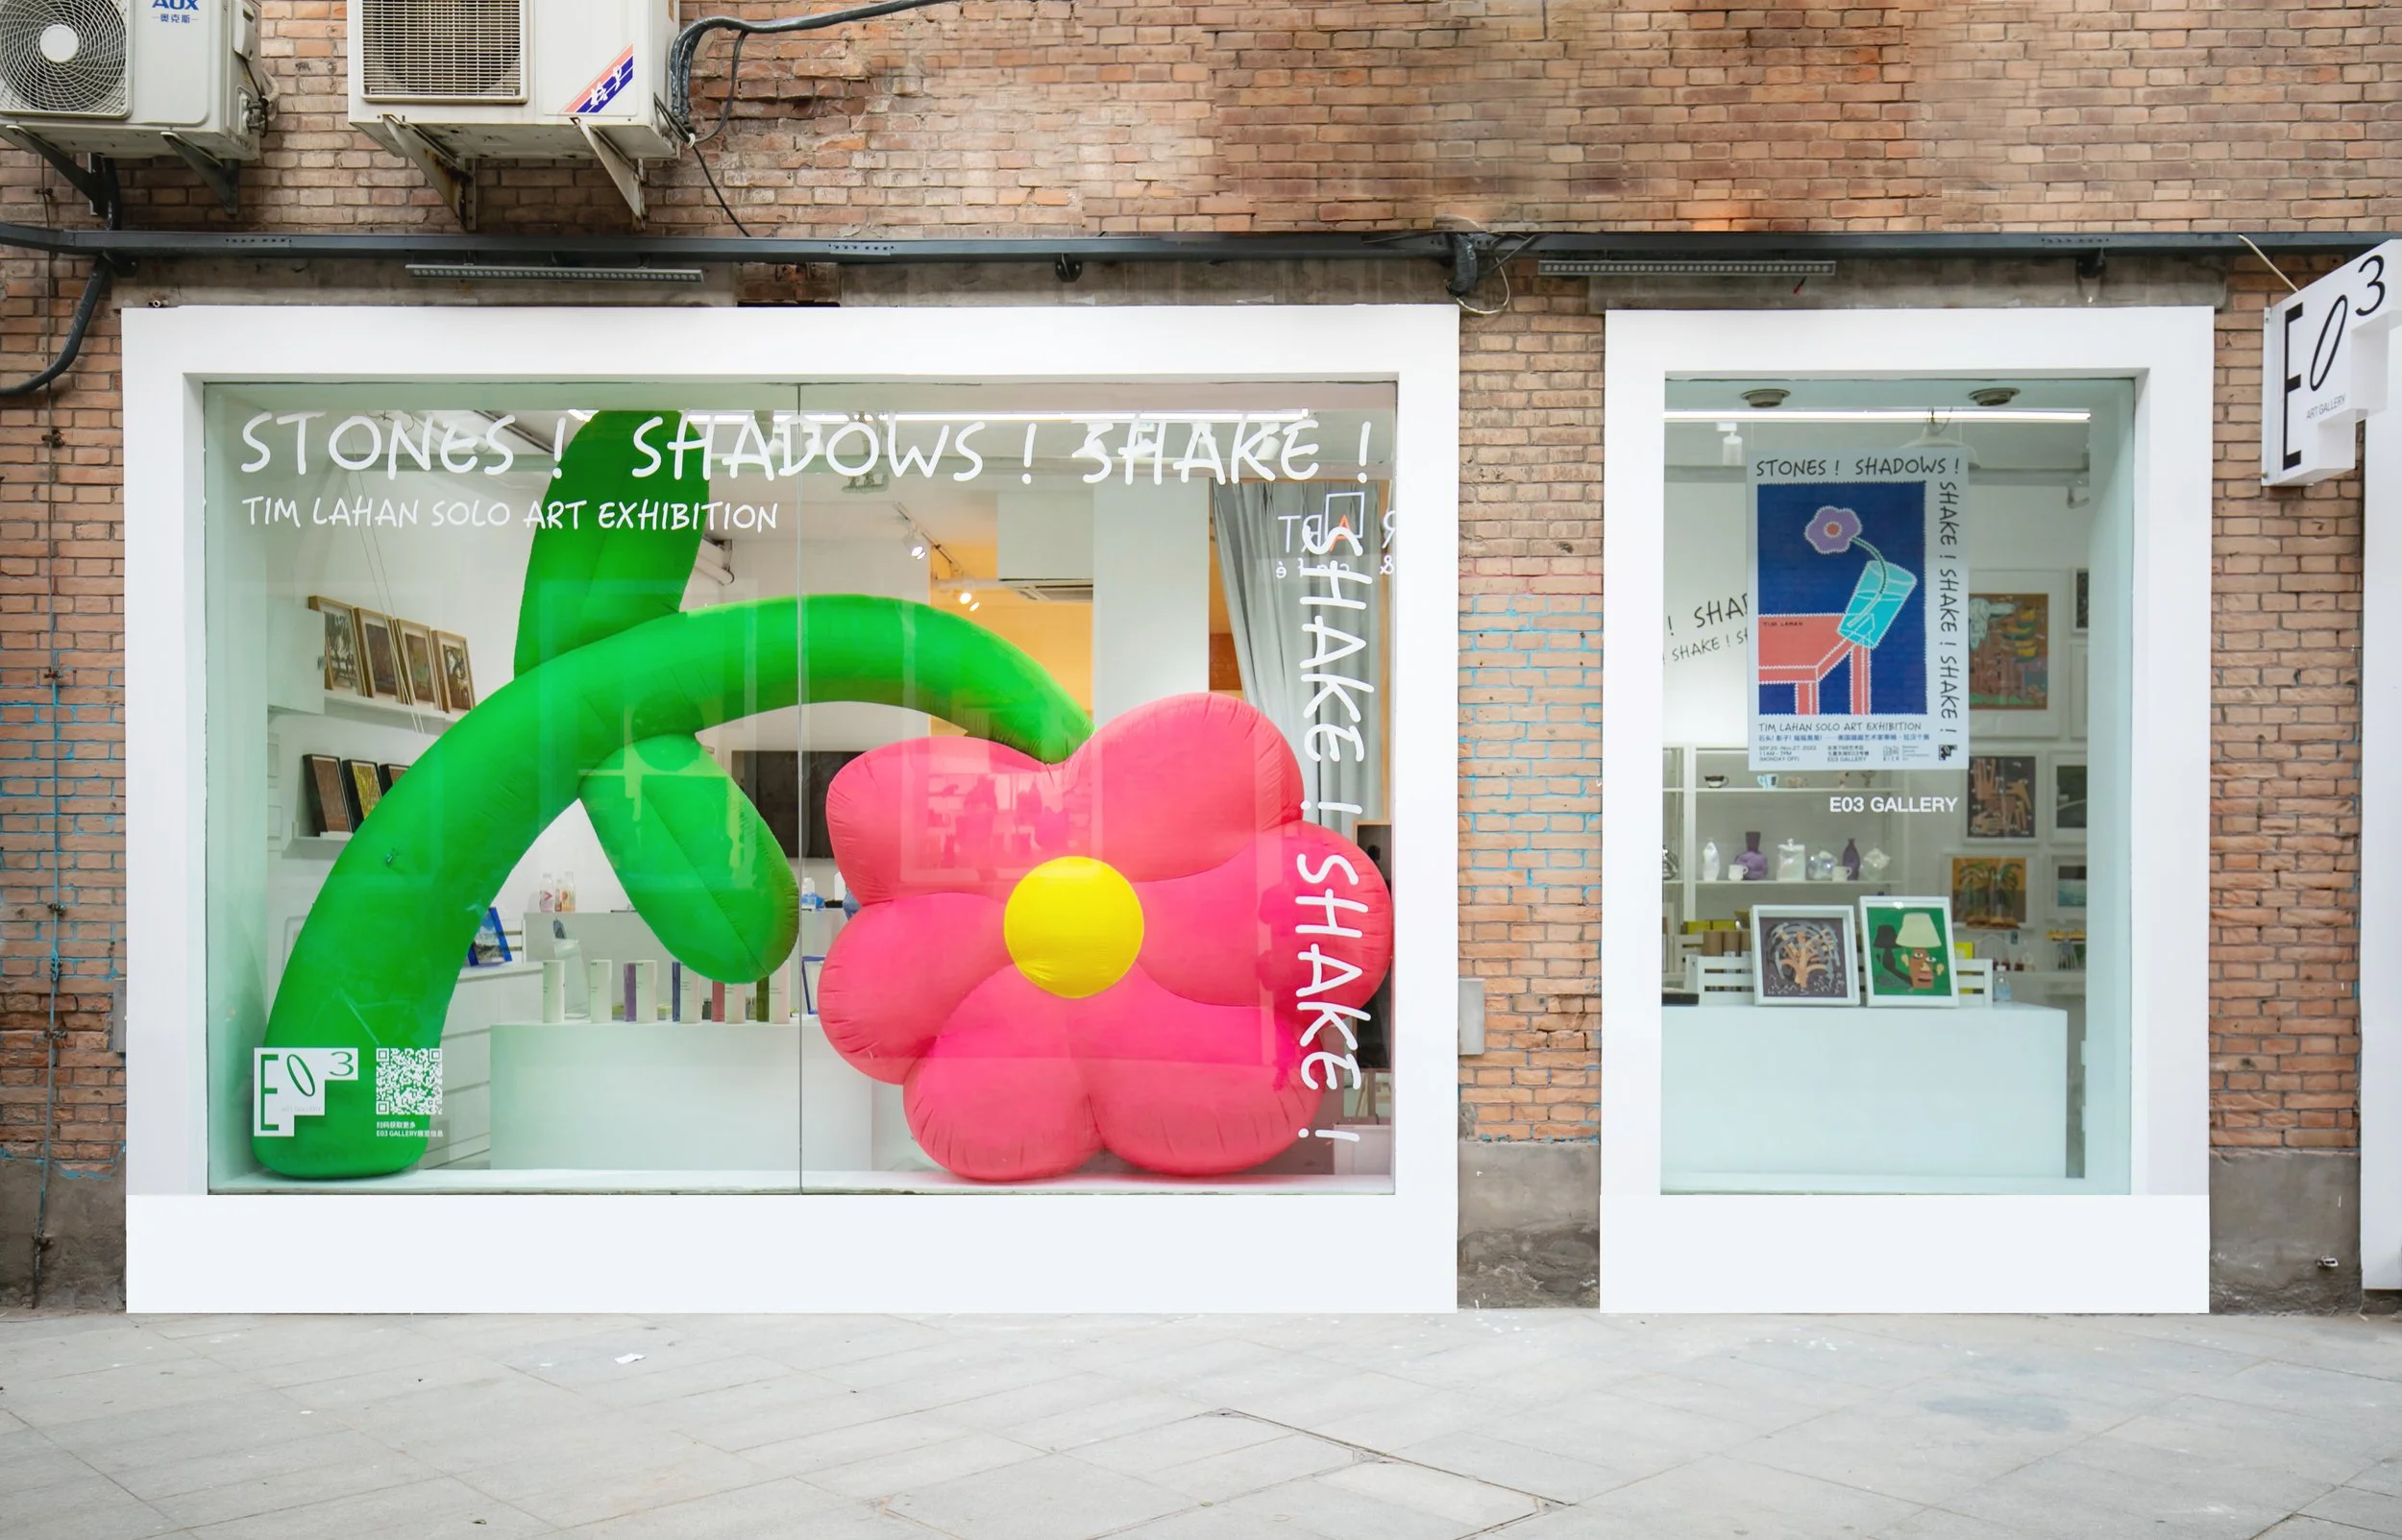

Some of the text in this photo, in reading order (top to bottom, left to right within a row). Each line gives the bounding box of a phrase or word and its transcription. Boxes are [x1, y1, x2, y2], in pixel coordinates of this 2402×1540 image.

[152, 0, 199, 11] AUX
[159, 13, 190, 24] 奥克斯
[2306, 393, 2346, 421] ART GALLERY
[241, 410, 516, 480] STONES
[633, 410, 986, 480] SHADOWS
[1083, 413, 1320, 486] SHAKE
[1756, 459, 1826, 477] STONES
[1855, 456, 1947, 476] SHADOWS
[241, 494, 779, 533] TIM LAHAN SOLO ART EXHIBITION
[1939, 481, 1960, 546] SHAKE
[1939, 569, 1960, 632] SHAKE
[1300, 526, 1374, 763] SHAKE
[1672, 636, 1721, 662] SHAKE
[1939, 655, 1960, 719] SHAKE
[1758, 721, 1922, 733] TIM LAHAN SOLO ART EXHIBITION
[1829, 796, 1959, 813] E03 GALLERY
[1295, 853, 1371, 1090] SHAKE
[260, 1051, 355, 1131] E03
